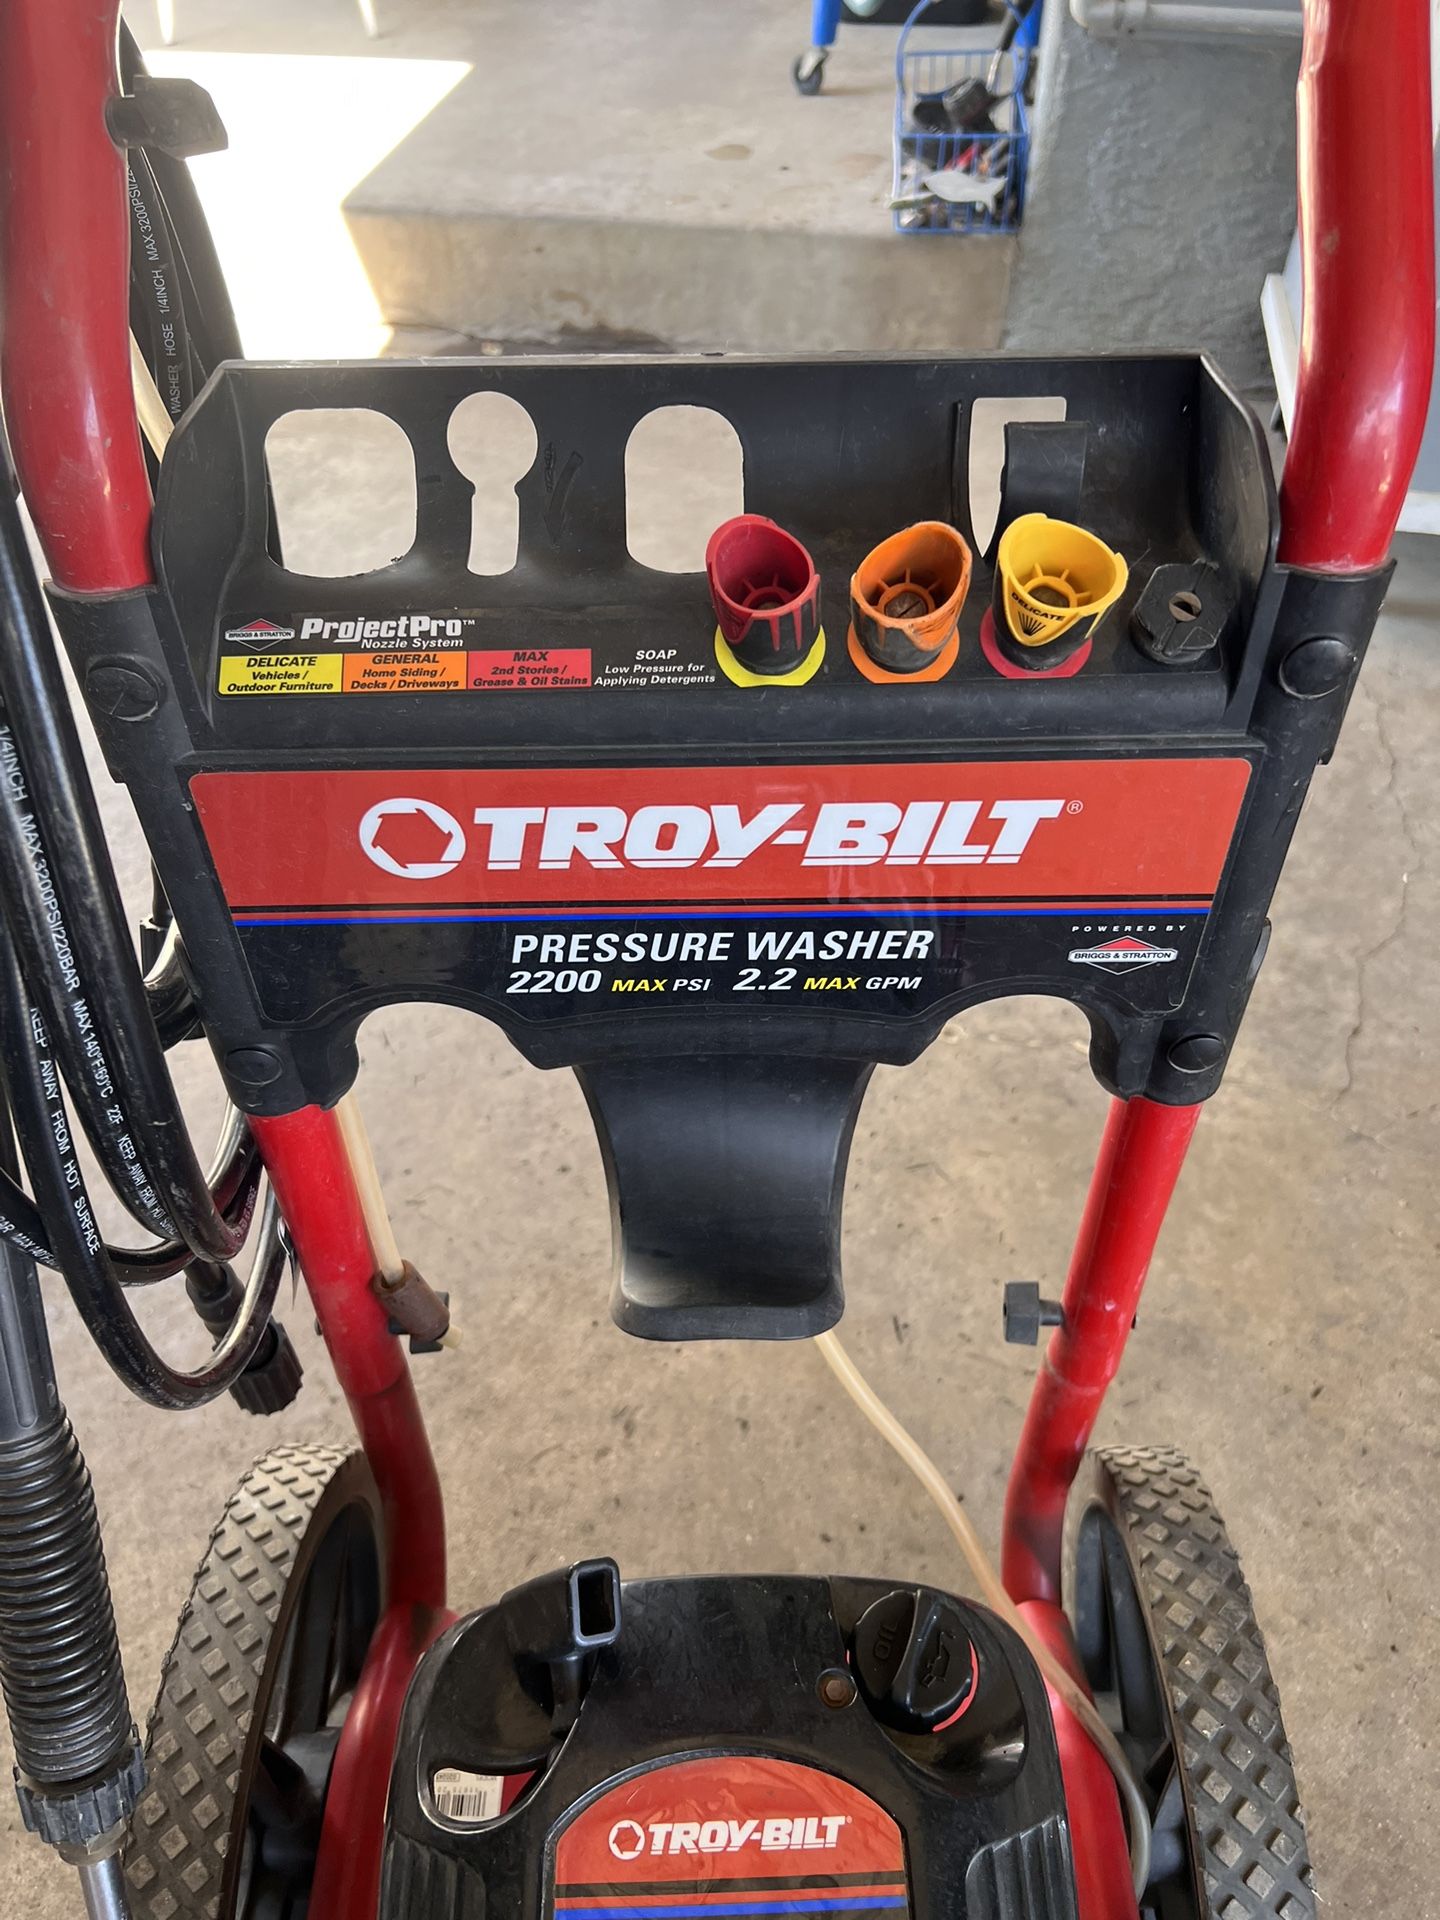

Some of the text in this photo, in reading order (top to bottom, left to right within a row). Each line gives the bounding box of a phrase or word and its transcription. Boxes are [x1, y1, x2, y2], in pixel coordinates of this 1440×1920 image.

[142, 233, 160, 261] MAX
[151, 269, 170, 314] 1/4INCH
[162, 323, 177, 356] HOSE
[167, 365, 182, 414] WASHER
[1011, 592, 1066, 621] DELICATE
[361, 637, 464, 650] Nozzle System
[372, 654, 440, 664] GENERAL
[513, 652, 549, 662] MAX
[635, 649, 677, 660] SOAP
[246, 656, 318, 668] DELICATE
[362, 668, 396, 678] Home
[400, 668, 438, 678] Siding
[491, 667, 514, 675] 2nd
[517, 666, 559, 675] Stories
[605, 663, 705, 674] Low Pressure for
[252, 671, 300, 681] Vehicles
[473, 676, 588, 687] Grease & Oil Stains
[594, 675, 716, 687] Applying Detergents
[227, 682, 334, 692] Outdoor Furniture
[350, 680, 388, 690] Decks
[397, 679, 459, 689] Driveways
[0, 725, 28, 801] 1/4INCH
[20, 814, 44, 858] MAX
[33, 858, 81, 993] 3200PSI/220BAR
[71, 998, 94, 1034] MAX
[117, 1133, 137, 1160] KEEP
[512, 930, 935, 963] PRESSURE WASHER
[506, 968, 922, 994] 2200 MAX PSI 2.2 MAX GPM
[40, 1059, 59, 1100] AWAY
[51, 1109, 71, 1155] FROM
[63, 1159, 81, 1190] HOT
[74, 1196, 100, 1256] SURFACE
[872, 1621, 898, 1661] OIL
